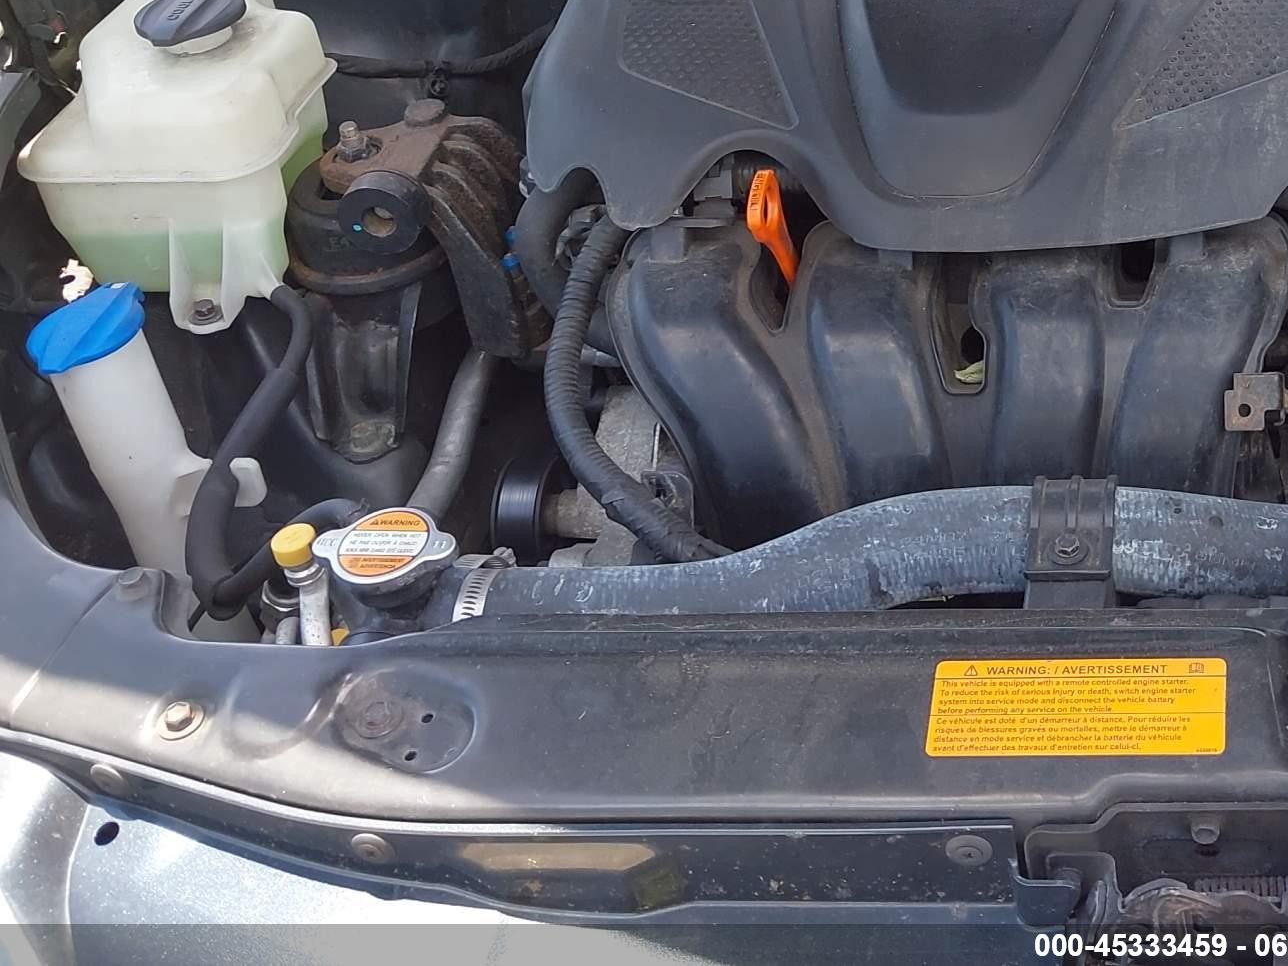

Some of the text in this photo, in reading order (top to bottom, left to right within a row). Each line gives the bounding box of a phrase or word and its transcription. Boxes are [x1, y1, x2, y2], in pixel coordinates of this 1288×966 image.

[986, 665, 1050, 675] WARNING:
[1062, 665, 1168, 674] AVERTISSEMENT
[999, 680, 1035, 689] equipped
[1133, 679, 1159, 687] engine
[1141, 687, 1168, 696] engine
[939, 698, 967, 707] system
[1147, 696, 1175, 704] battery
[964, 707, 1008, 716] performing
[1010, 707, 1025, 715] any
[998, 716, 1016, 724] doté
[1020, 716, 1037, 724] d'un
[1039, 716, 1080, 724] démarreur
[1127, 715, 1146, 723] Pour
[1019, 726, 1046, 734] graves
[1046, 734, 1092, 742] débrancher
[1148, 733, 1182, 741] véhicule
[1049, 743, 1094, 751] d'entretien
